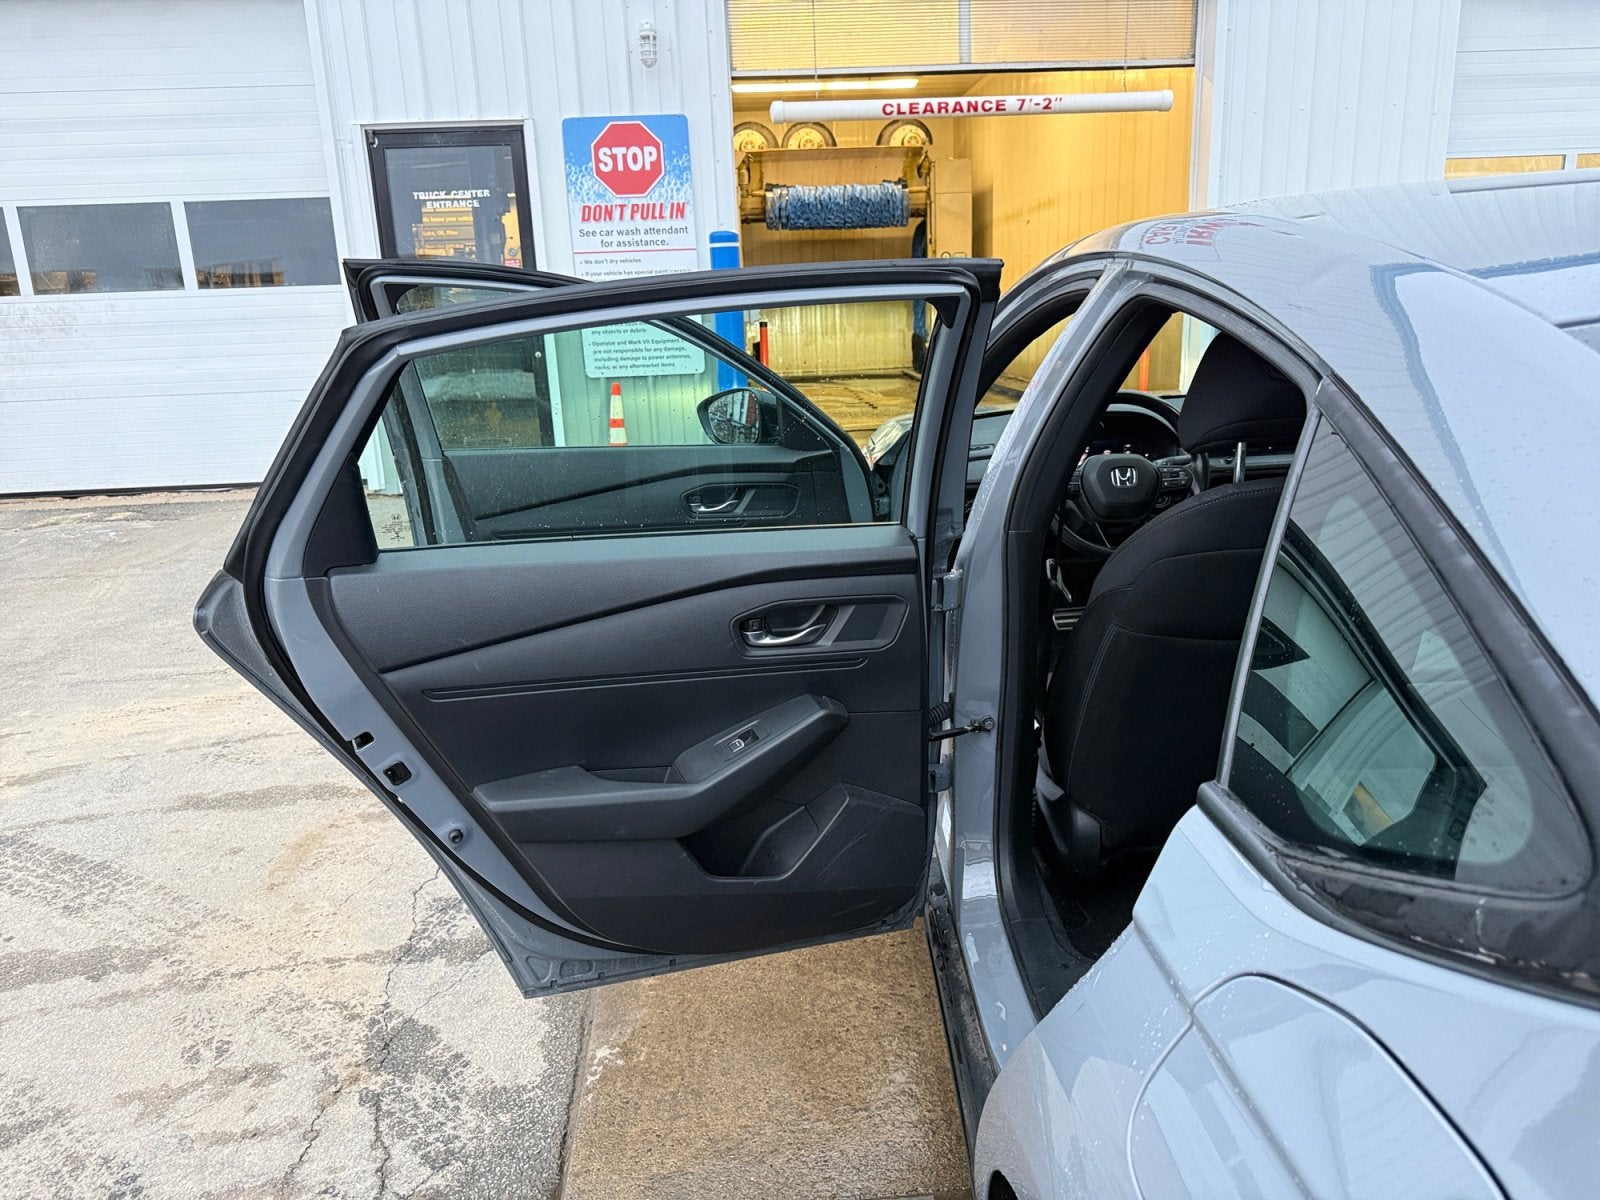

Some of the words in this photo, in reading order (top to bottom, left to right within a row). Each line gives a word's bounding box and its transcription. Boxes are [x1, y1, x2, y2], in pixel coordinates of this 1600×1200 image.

[882, 99, 1007, 116] CLEARANCE
[598, 146, 658, 172] STOP
[412, 191, 447, 200] TRUCK
[450, 189, 491, 199] CENTER
[426, 200, 480, 208] ENTRANCE
[581, 203, 627, 222] DON'T
[630, 202, 665, 221] PULL
[669, 202, 686, 219] IN
[579, 229, 597, 237] See
[600, 229, 614, 237] car
[616, 227, 640, 236] wash
[643, 226, 689, 236] attendant
[600, 239, 613, 248] for
[616, 238, 670, 247] assistance.
[609, 258, 618, 266] dry
[634, 268, 654, 276] special
